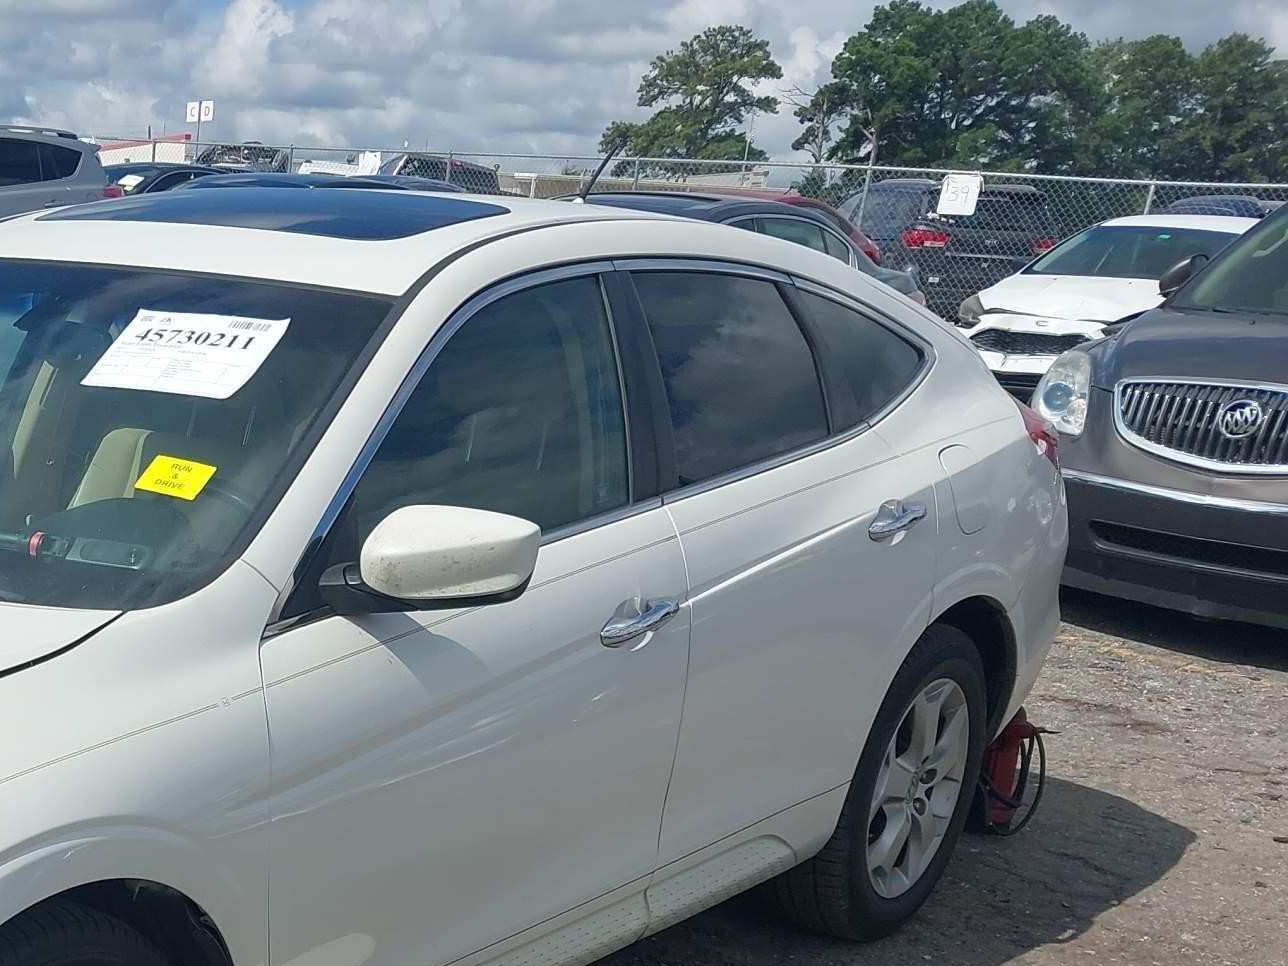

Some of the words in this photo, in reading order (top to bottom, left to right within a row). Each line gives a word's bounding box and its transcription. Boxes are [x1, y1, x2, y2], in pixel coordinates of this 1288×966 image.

[135, 327, 255, 350] 45730211
[170, 463, 193, 473] RUN
[154, 479, 185, 490] DRIVE
